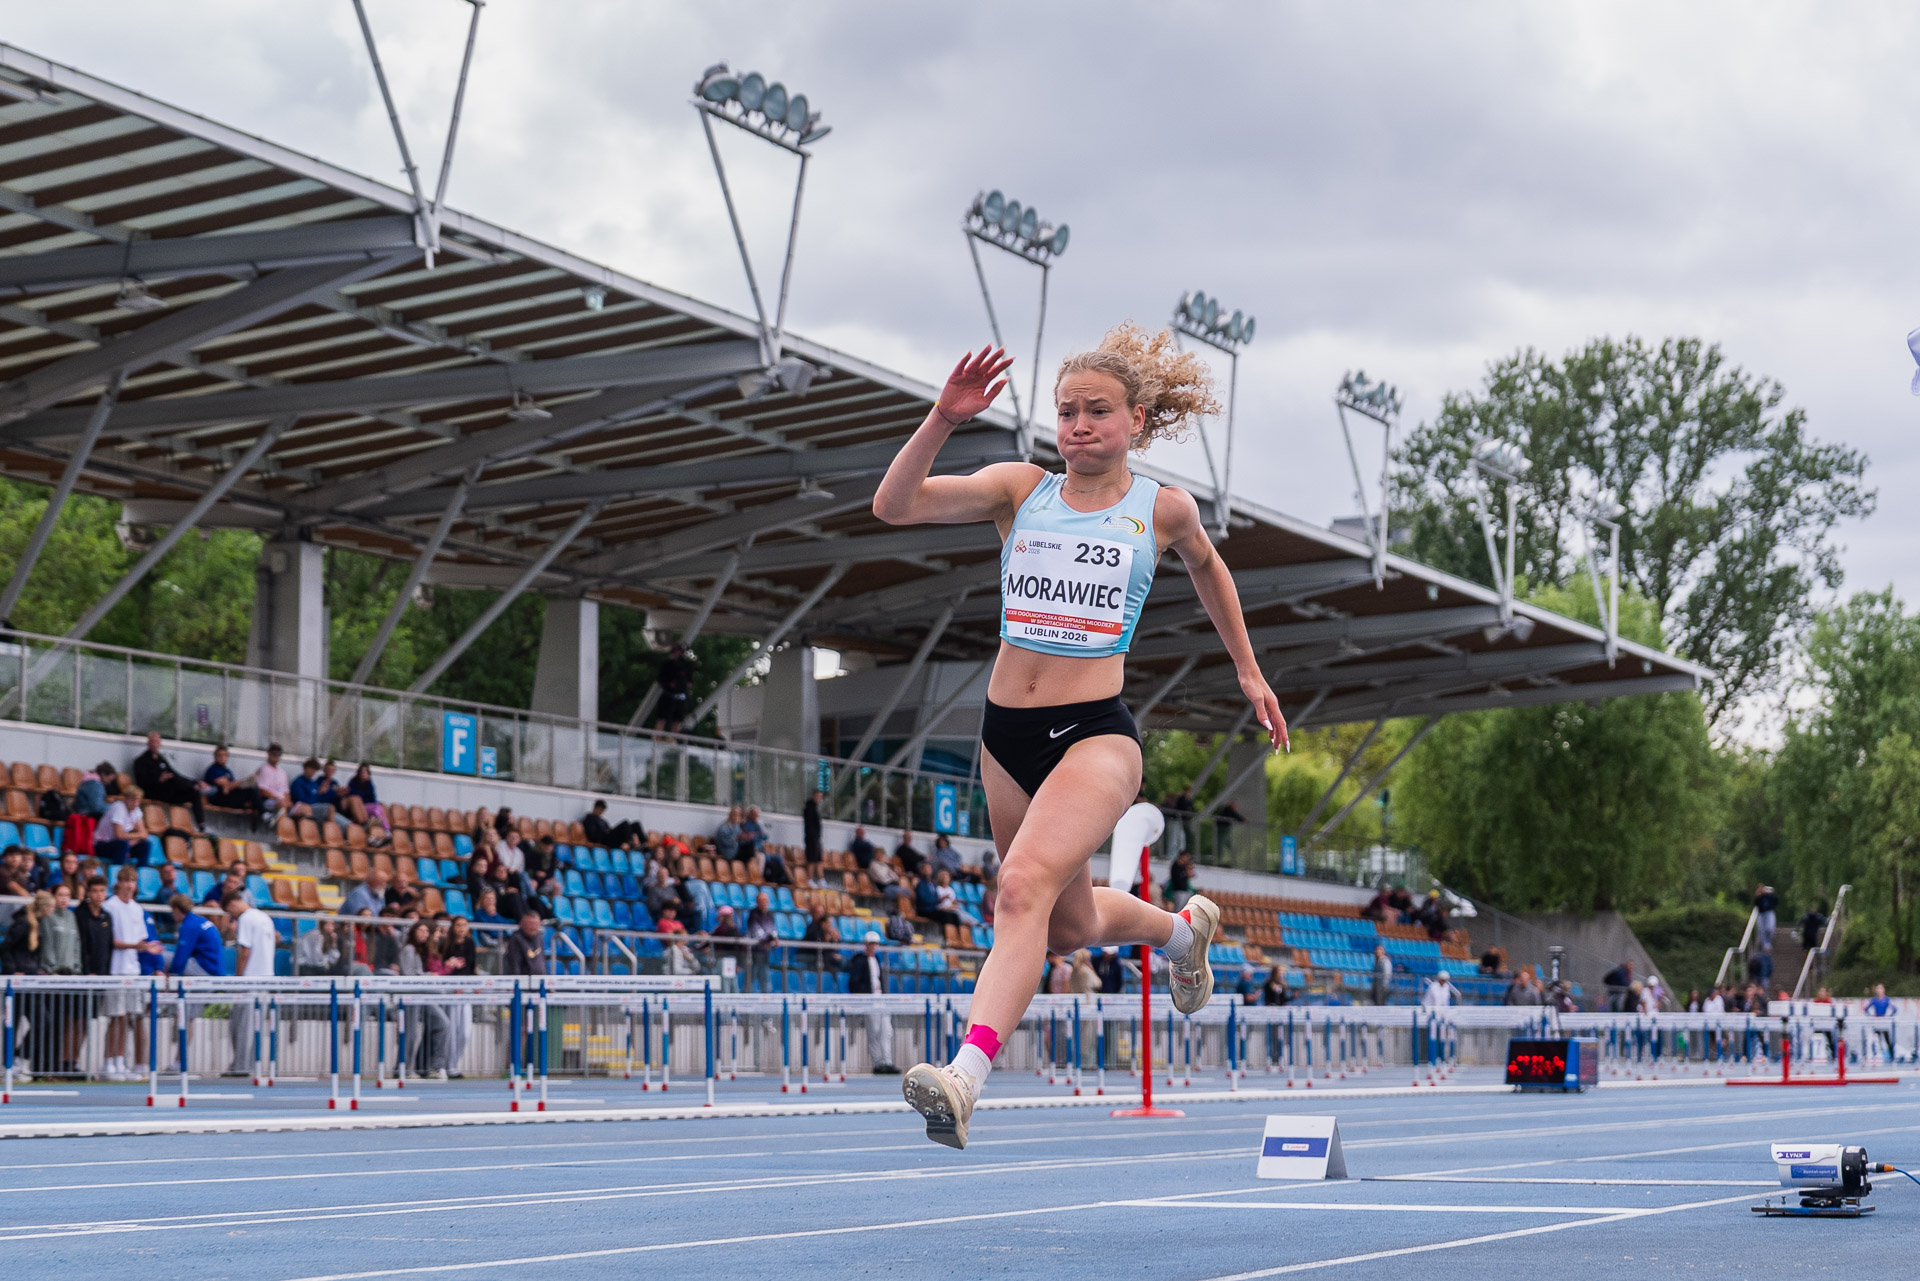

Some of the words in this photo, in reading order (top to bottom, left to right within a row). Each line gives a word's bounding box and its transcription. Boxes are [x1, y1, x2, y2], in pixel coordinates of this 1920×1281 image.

[1029, 540, 1062, 551] LUBELSKIE
[1074, 543, 1121, 567] 233
[1006, 573, 1122, 609] MORAWIEC
[1037, 619, 1064, 628] SPORTACH
[1064, 622, 1086, 630] LETNICH
[1057, 616, 1086, 625] OLIMPIADA
[1024, 626, 1059, 639] LUBLIN
[1061, 630, 1088, 642] 2026
[452, 728, 468, 768] F
[939, 797, 952, 828] G
